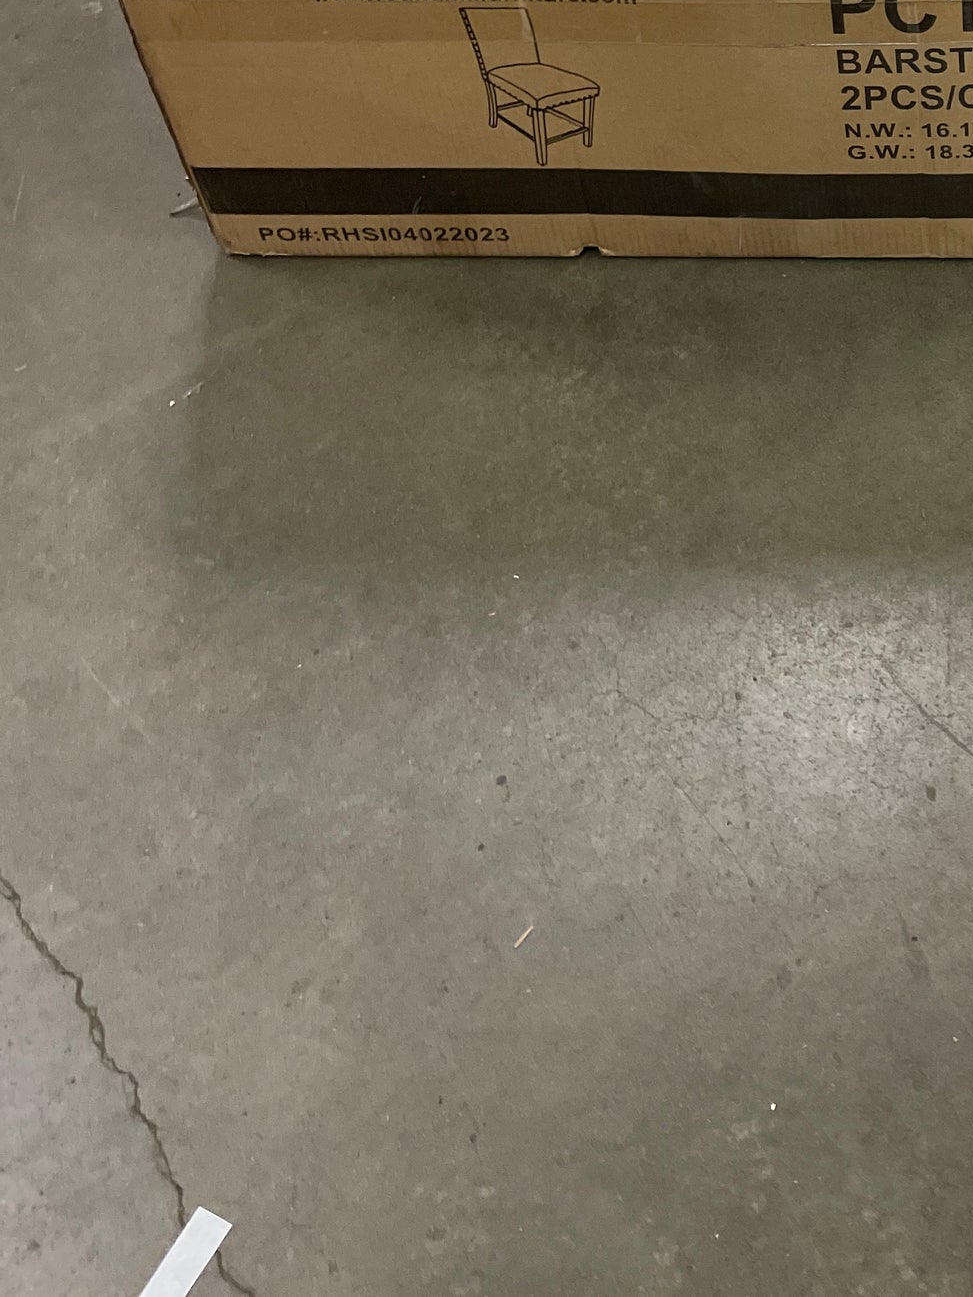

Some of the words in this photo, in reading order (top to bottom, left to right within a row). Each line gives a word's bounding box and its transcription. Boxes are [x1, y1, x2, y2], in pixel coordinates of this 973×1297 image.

[844, 122, 912, 139] N.W.:
[847, 143, 916, 160] G.W.:
[258, 227, 510, 242] PO#:RHSI04022023
